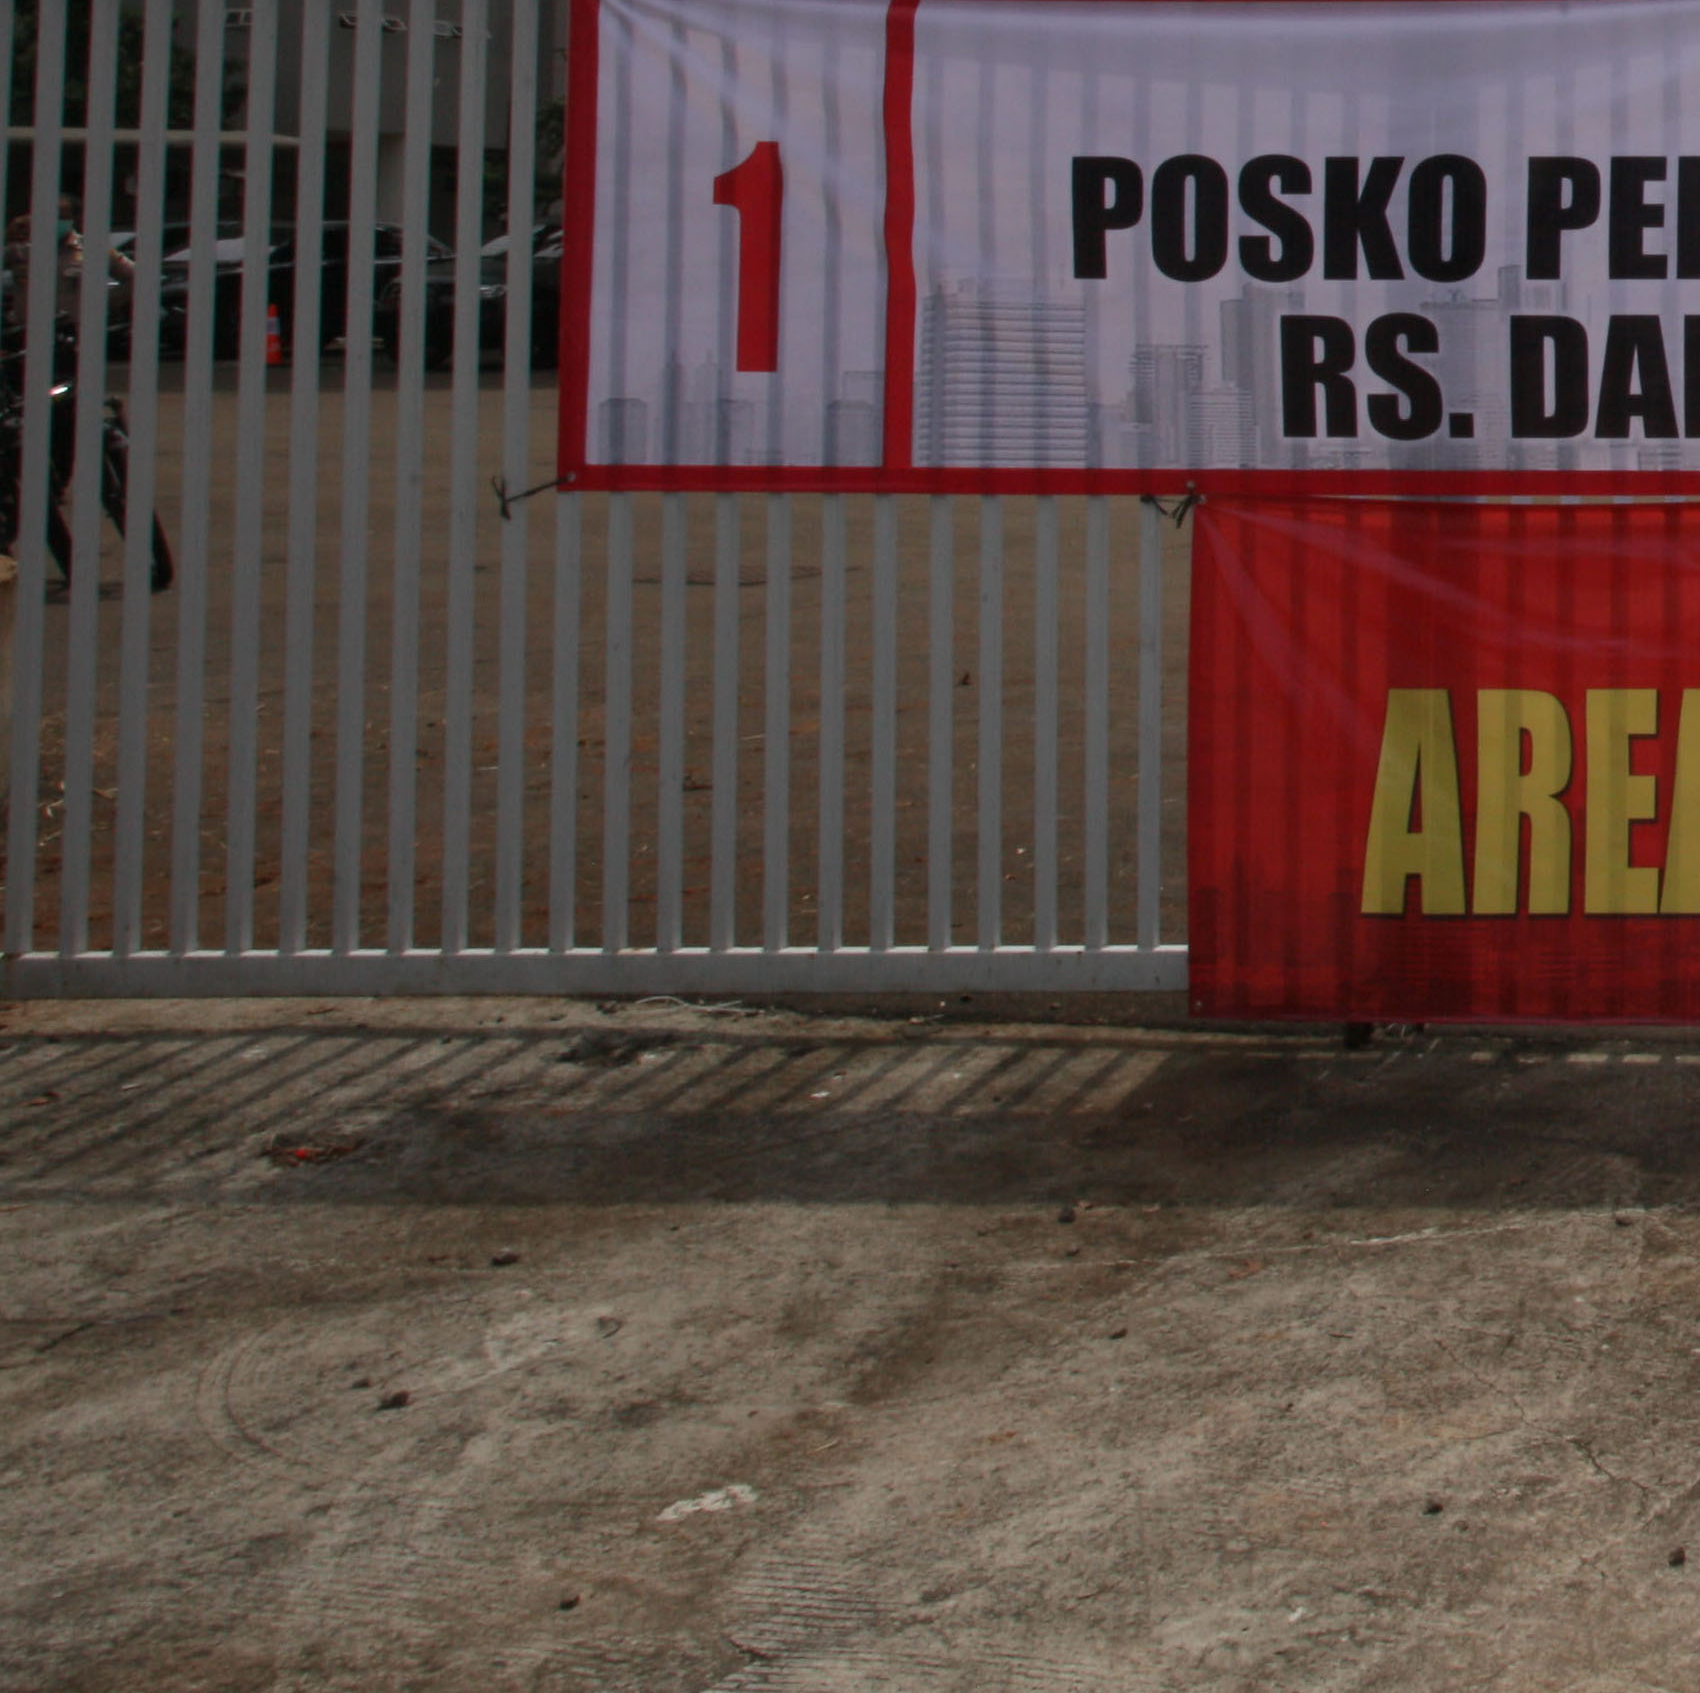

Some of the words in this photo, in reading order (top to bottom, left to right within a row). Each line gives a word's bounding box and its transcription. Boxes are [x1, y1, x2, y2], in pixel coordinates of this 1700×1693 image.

[714, 141, 783, 372] 1
[1071, 153, 1487, 283] POSKO
[1280, 312, 1474, 442] RS.
